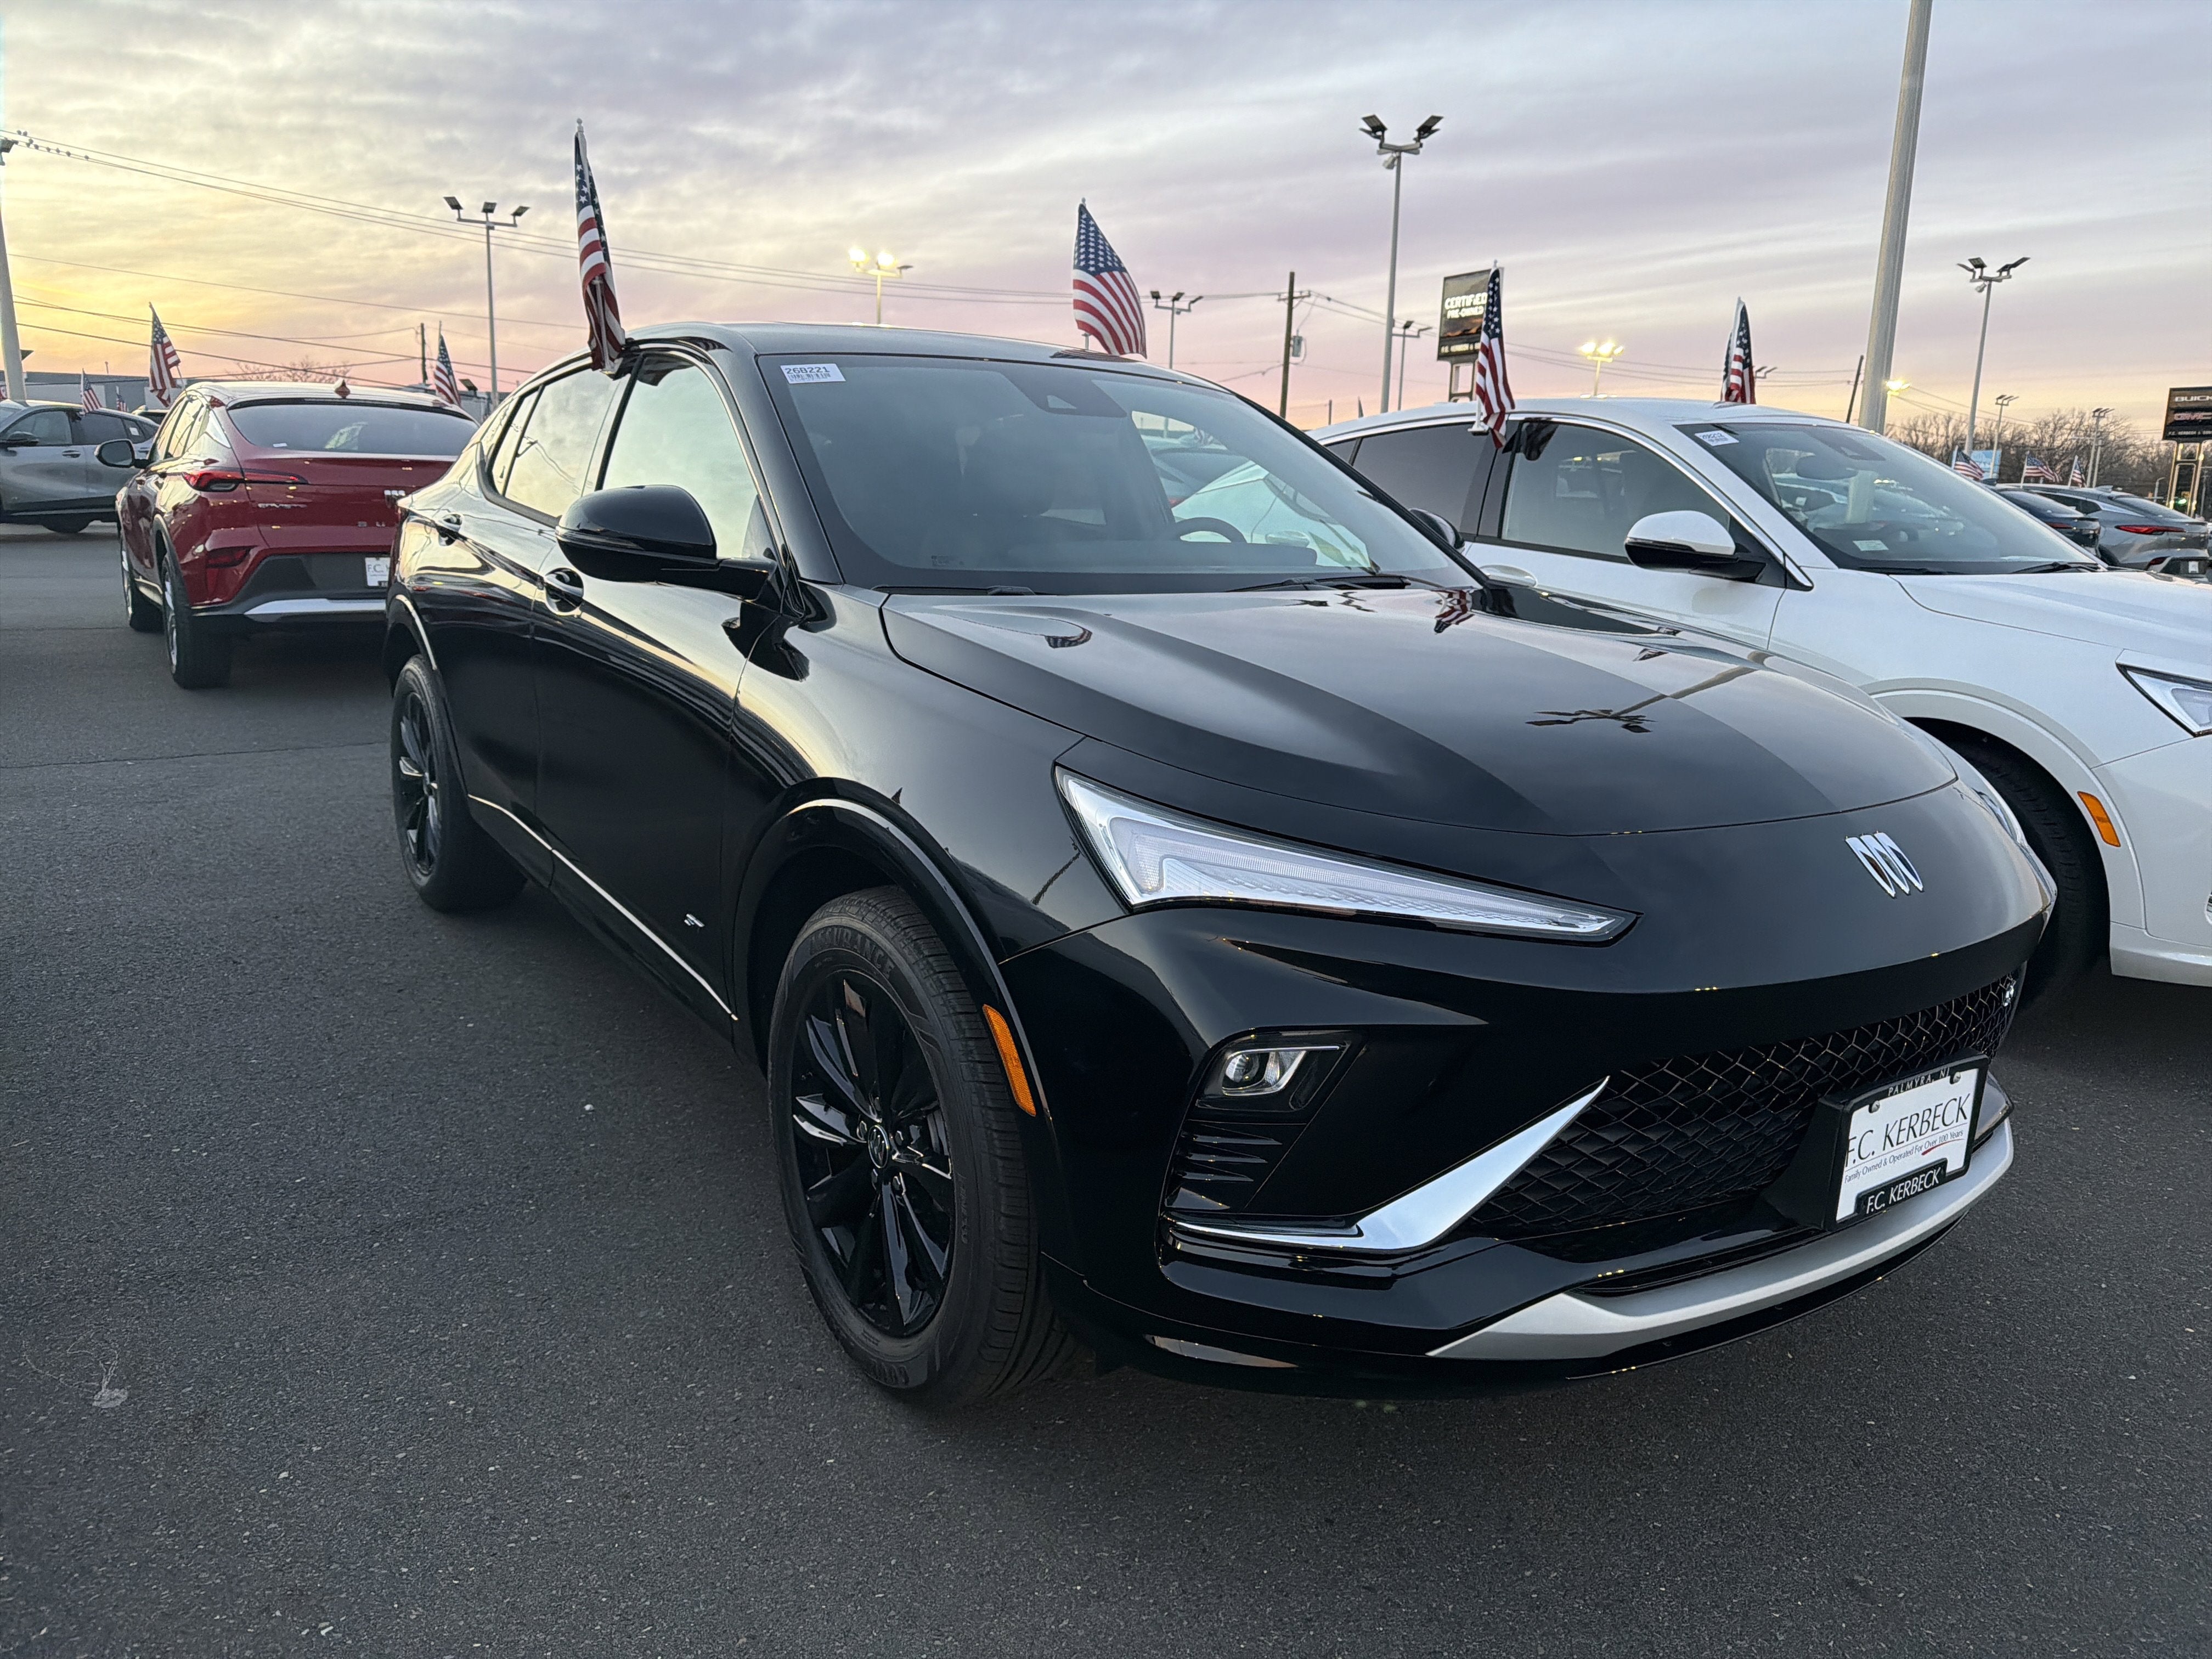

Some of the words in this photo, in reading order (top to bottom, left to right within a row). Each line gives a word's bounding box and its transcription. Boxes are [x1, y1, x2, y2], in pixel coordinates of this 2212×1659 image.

[1444, 292, 1488, 309] CERTIFIED
[809, 927, 895, 981] ASSURANCE
[1844, 1169, 1861, 1183] Family
[1862, 1160, 1883, 1175] Owned
[1883, 1158, 1887, 1166] &
[1889, 1147, 1915, 1164] Operated
[1915, 1144, 1923, 1153] For
[1924, 1138, 1939, 1149] Over
[1939, 1133, 1949, 1143] 100
[1950, 1130, 1963, 1139] Years
[1845, 1130, 1875, 1167] F.C.
[1883, 1093, 1971, 1151] KERBECK
[1866, 1191, 1886, 1214] F.C.
[1889, 1166, 1942, 1205] KERBECK
